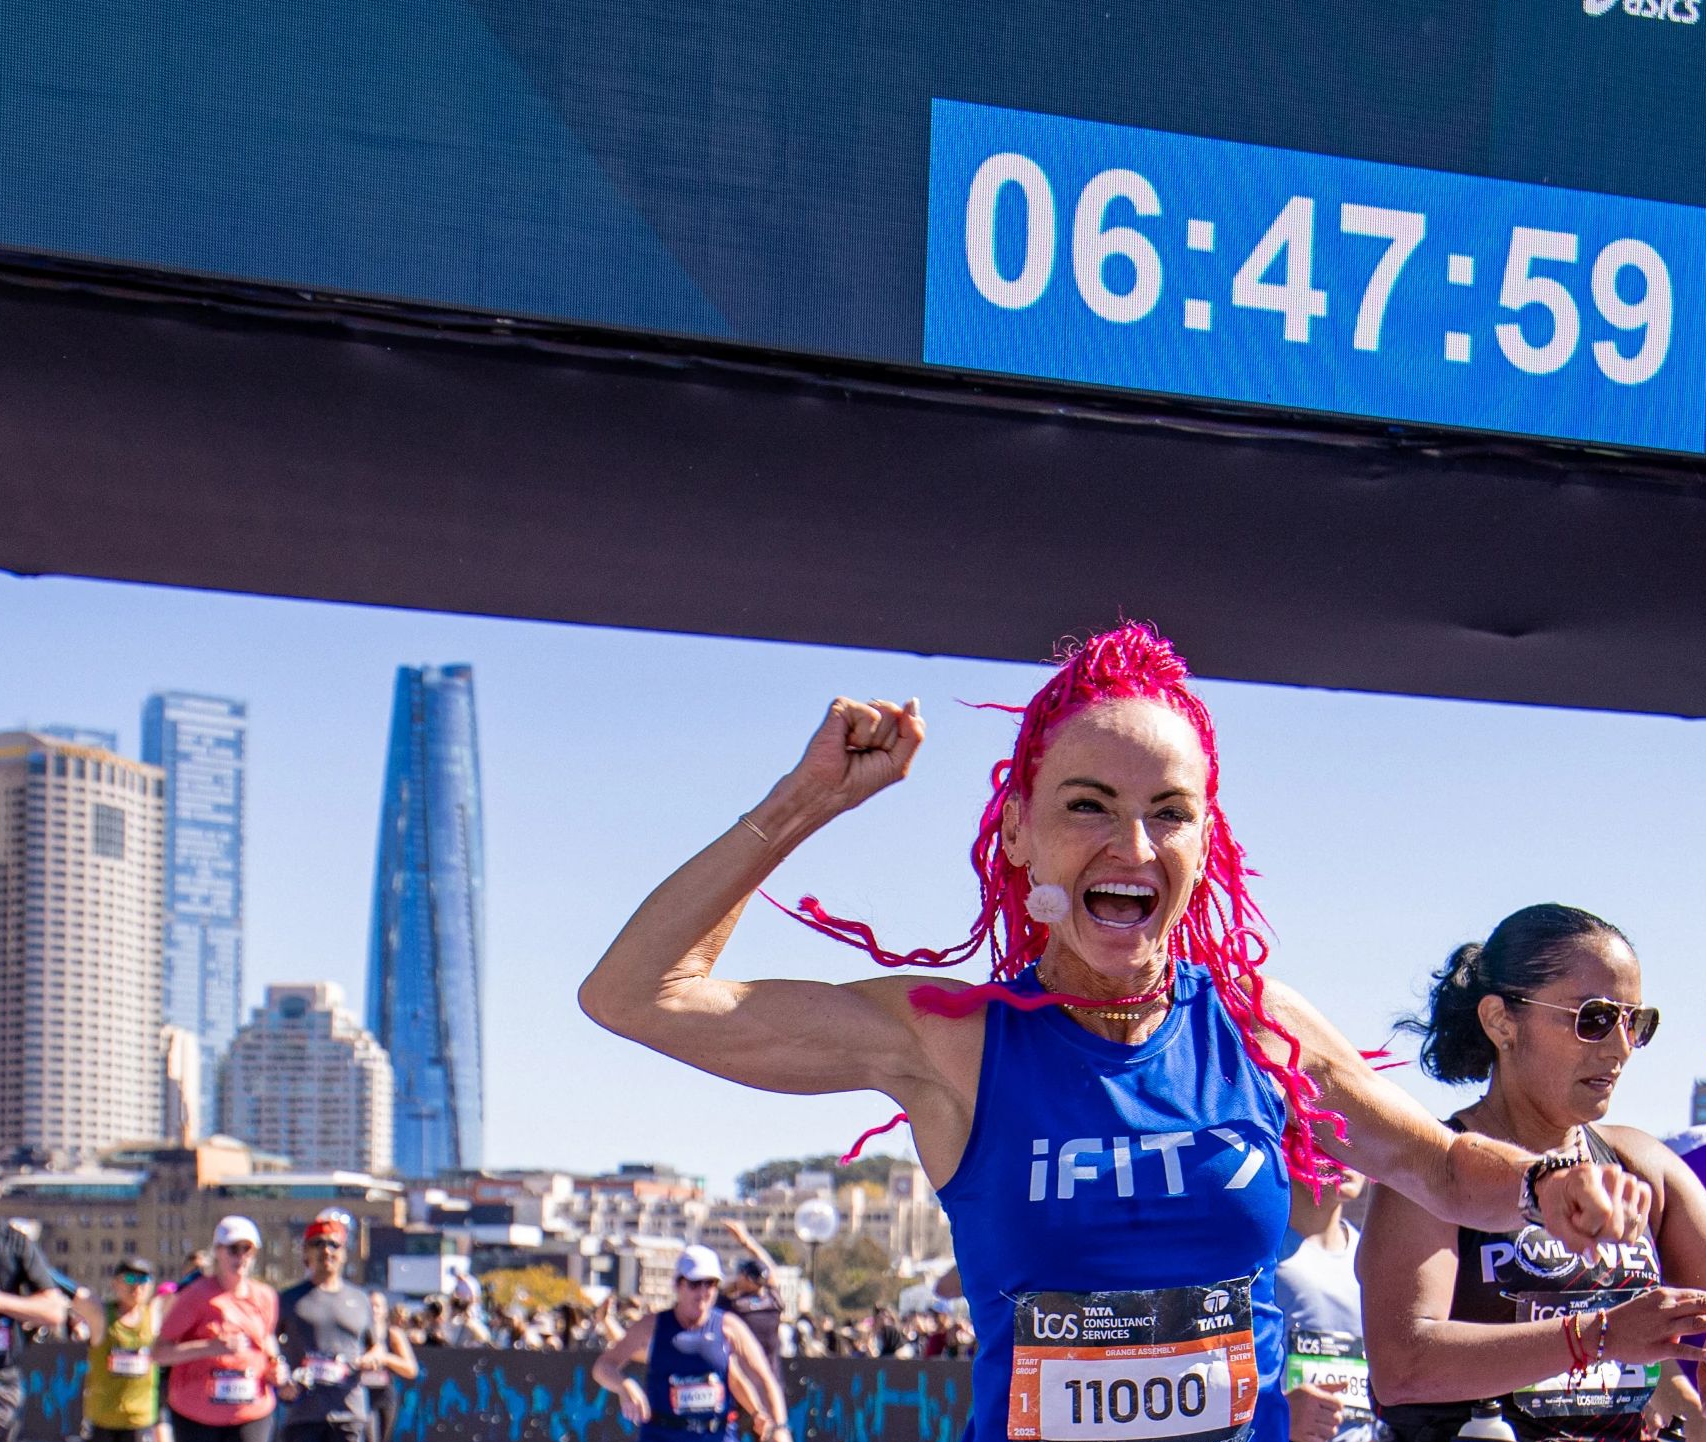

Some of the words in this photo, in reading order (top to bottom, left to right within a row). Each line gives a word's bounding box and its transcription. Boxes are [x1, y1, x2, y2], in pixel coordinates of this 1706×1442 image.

[964, 151, 1674, 387] 06:47:59
[1082, 1306, 1114, 1317] TATA
[1033, 1306, 1079, 1340] tcs
[1082, 1316, 1157, 1329] CONSULTANCY
[1197, 1313, 1234, 1332] TATA
[1082, 1329, 1130, 1341] SERVICES
[1229, 1342, 1252, 1353] CHUTE
[1297, 1335, 1320, 1354] tcs
[1105, 1347, 1137, 1357] ORANGE
[1137, 1345, 1176, 1356] ASSEMBLY
[1229, 1352, 1252, 1362] ENTRY
[1016, 1357, 1038, 1366] START
[1015, 1367, 1038, 1376] GROUP
[1019, 1392, 1028, 1413] 1
[1064, 1372, 1207, 1425] 11000
[1237, 1378, 1250, 1399] F
[1013, 1427, 1036, 1437] 2025
